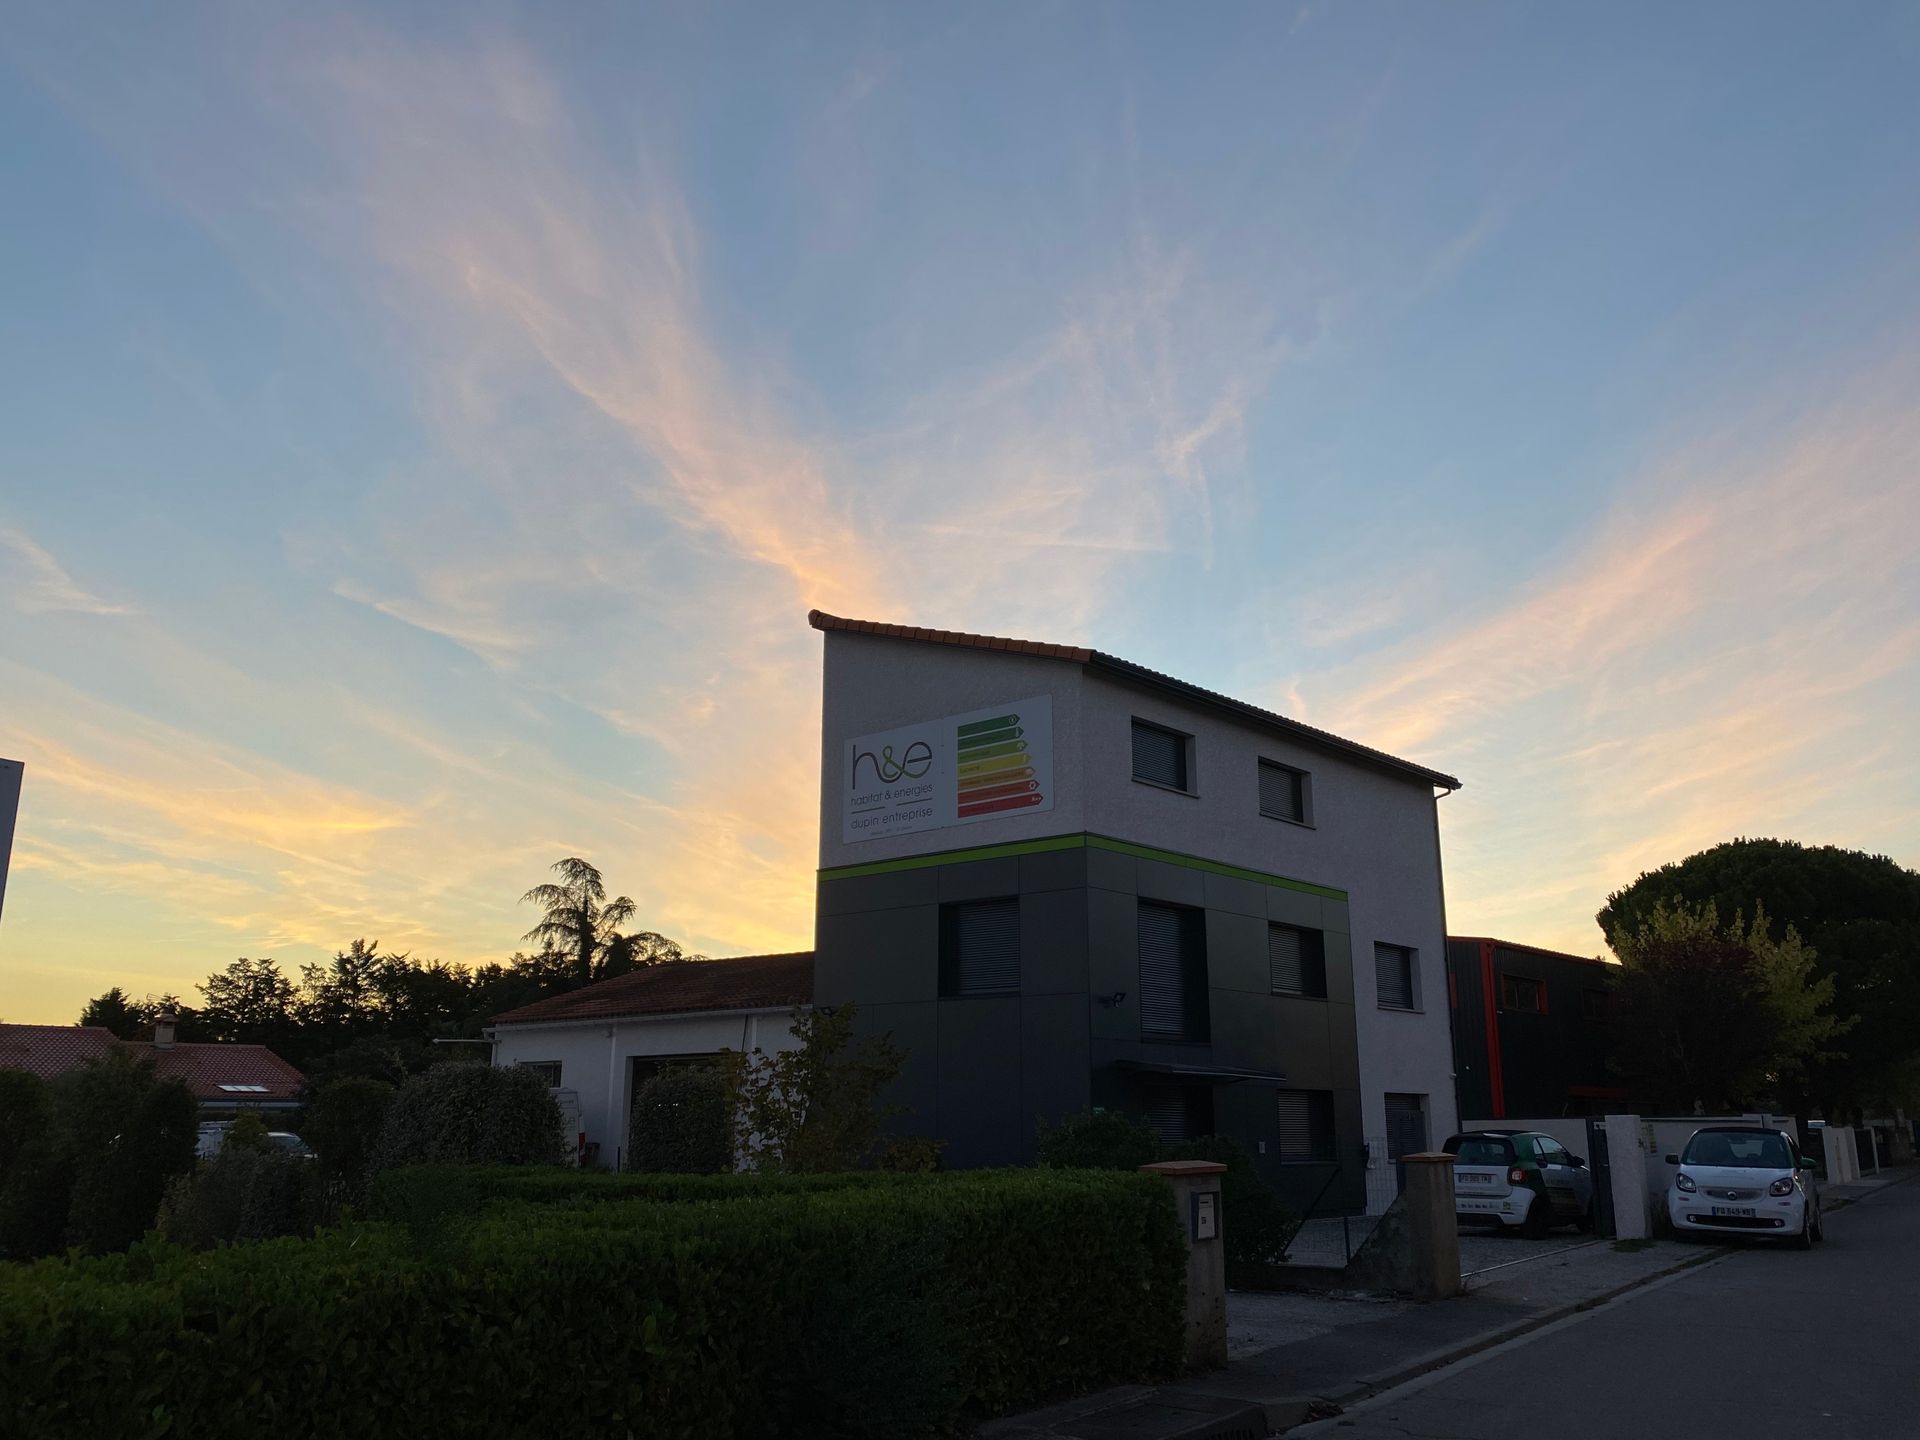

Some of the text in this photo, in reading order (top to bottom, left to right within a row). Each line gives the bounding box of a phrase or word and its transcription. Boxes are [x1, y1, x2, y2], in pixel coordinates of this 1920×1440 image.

[851, 792, 882, 806] habitat
[884, 790, 891, 800] &
[851, 807, 933, 829] dupin entreprise
